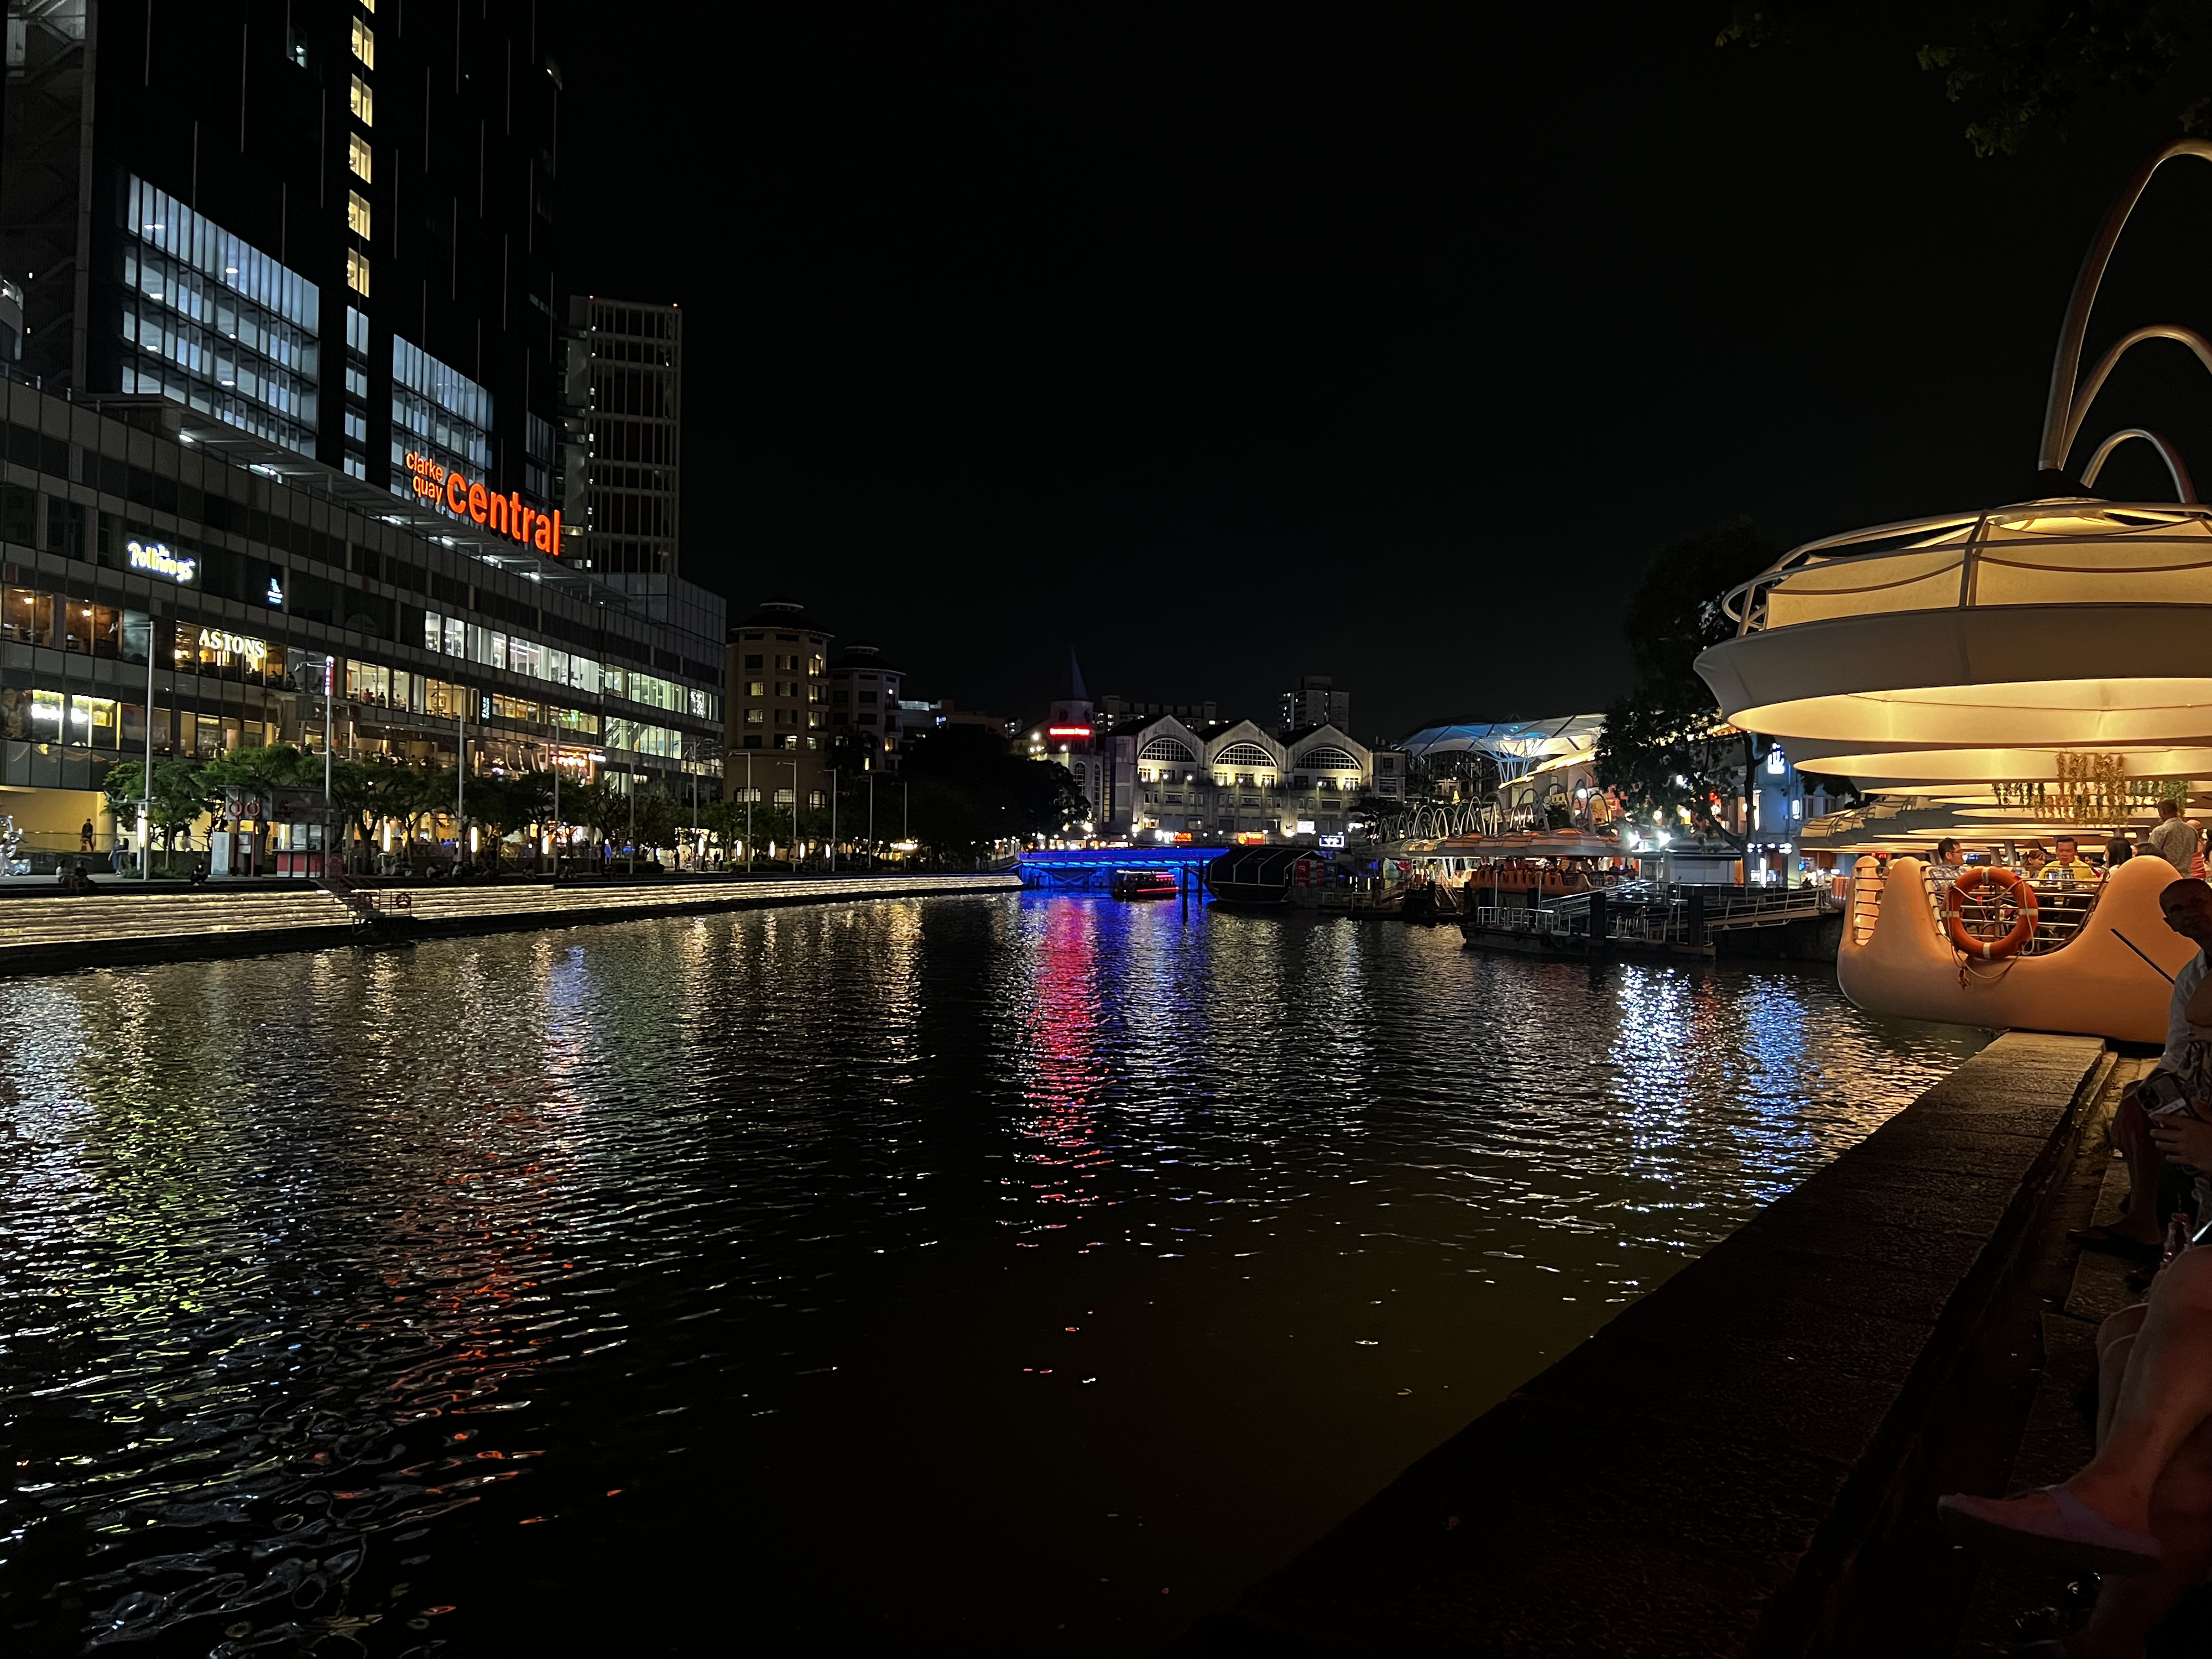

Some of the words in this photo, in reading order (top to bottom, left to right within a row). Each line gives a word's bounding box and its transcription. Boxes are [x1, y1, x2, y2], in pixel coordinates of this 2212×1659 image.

[406, 451, 444, 482] clarke
[413, 475, 443, 505] quay
[447, 472, 560, 556] central
[199, 629, 265, 659] ASTONS
